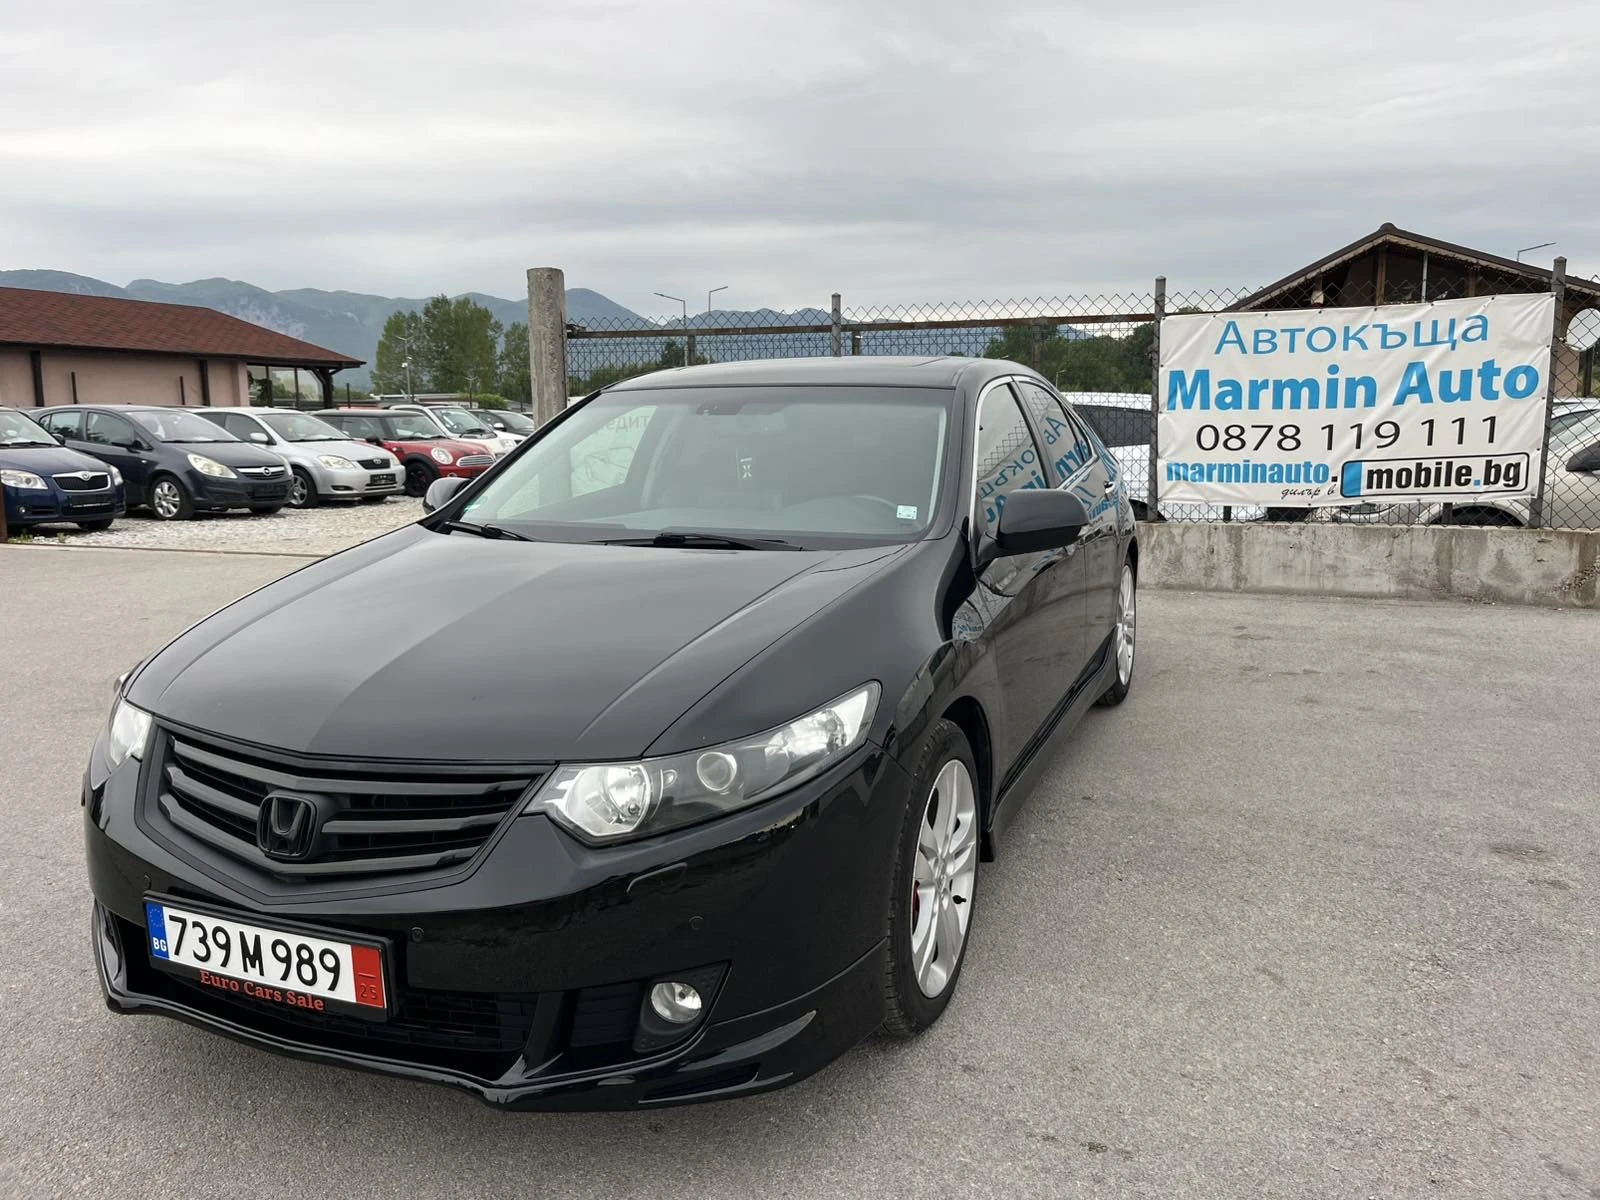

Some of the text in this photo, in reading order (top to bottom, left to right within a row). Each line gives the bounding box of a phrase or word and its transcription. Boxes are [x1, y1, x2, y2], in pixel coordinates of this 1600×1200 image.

[1214, 314, 1488, 356] Автокъща
[1166, 359, 1540, 412] Marmin Auto
[1196, 416, 1497, 451] 0878 119 111
[1366, 459, 1521, 489] mobile.bg
[153, 937, 167, 952] BG
[200, 971, 324, 1011] Euro Cars Sale
